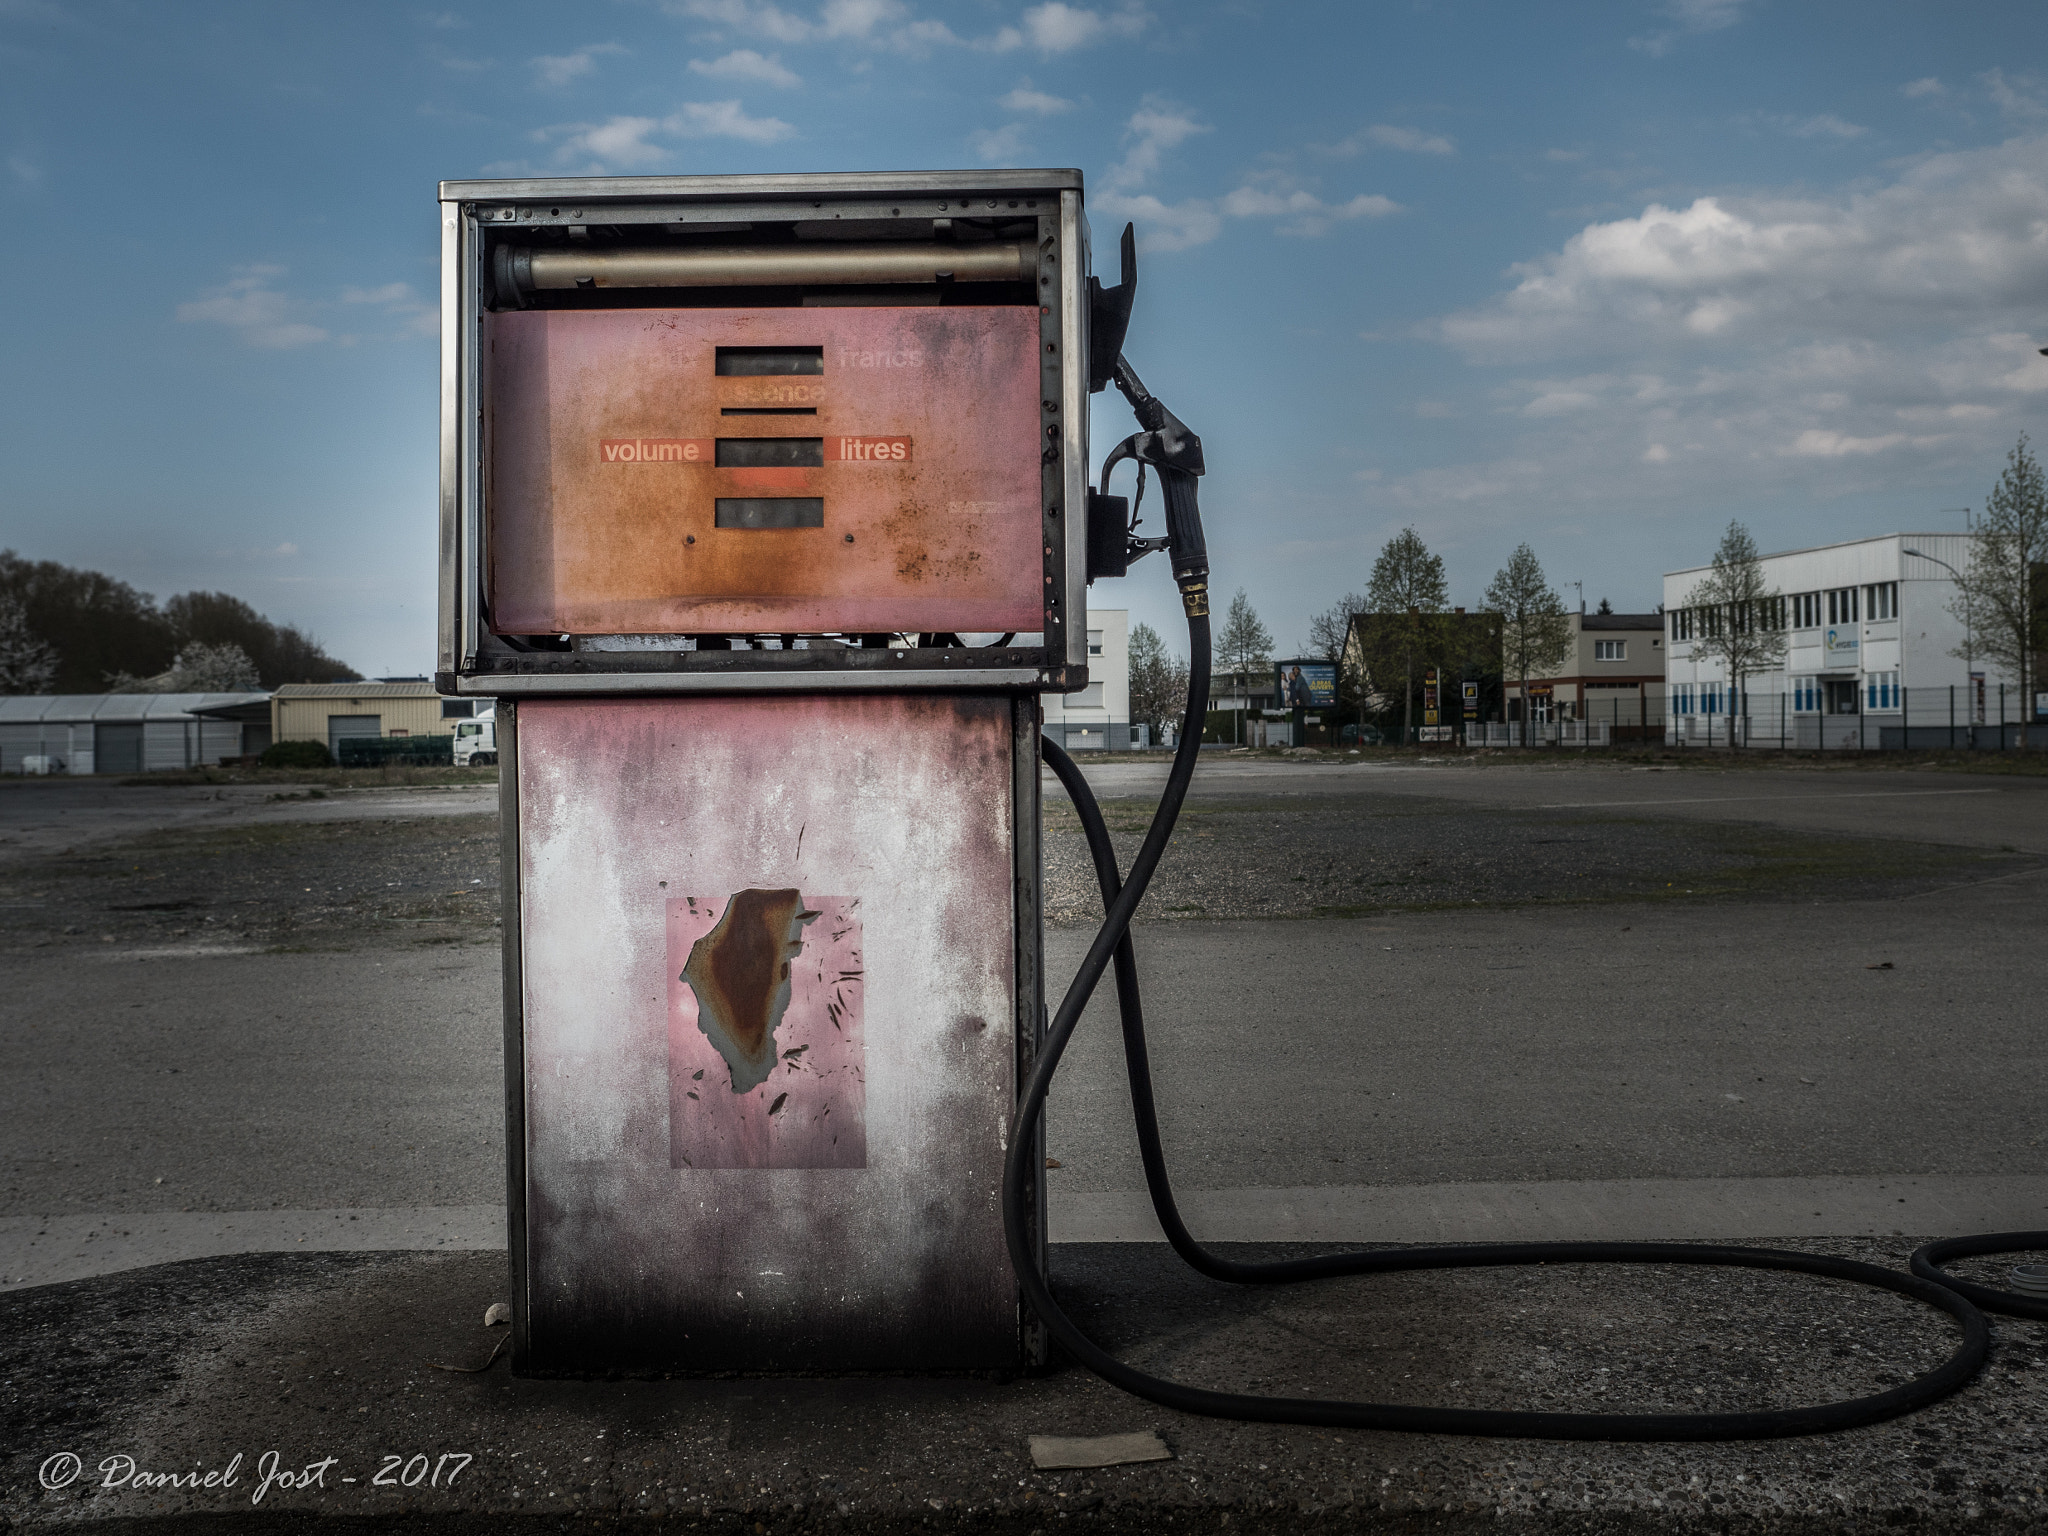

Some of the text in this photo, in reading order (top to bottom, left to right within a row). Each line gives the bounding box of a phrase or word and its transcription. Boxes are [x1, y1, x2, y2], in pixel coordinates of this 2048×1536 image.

[839, 347, 924, 367] francs
[717, 384, 826, 402] essence
[604, 438, 906, 461] volume litres
